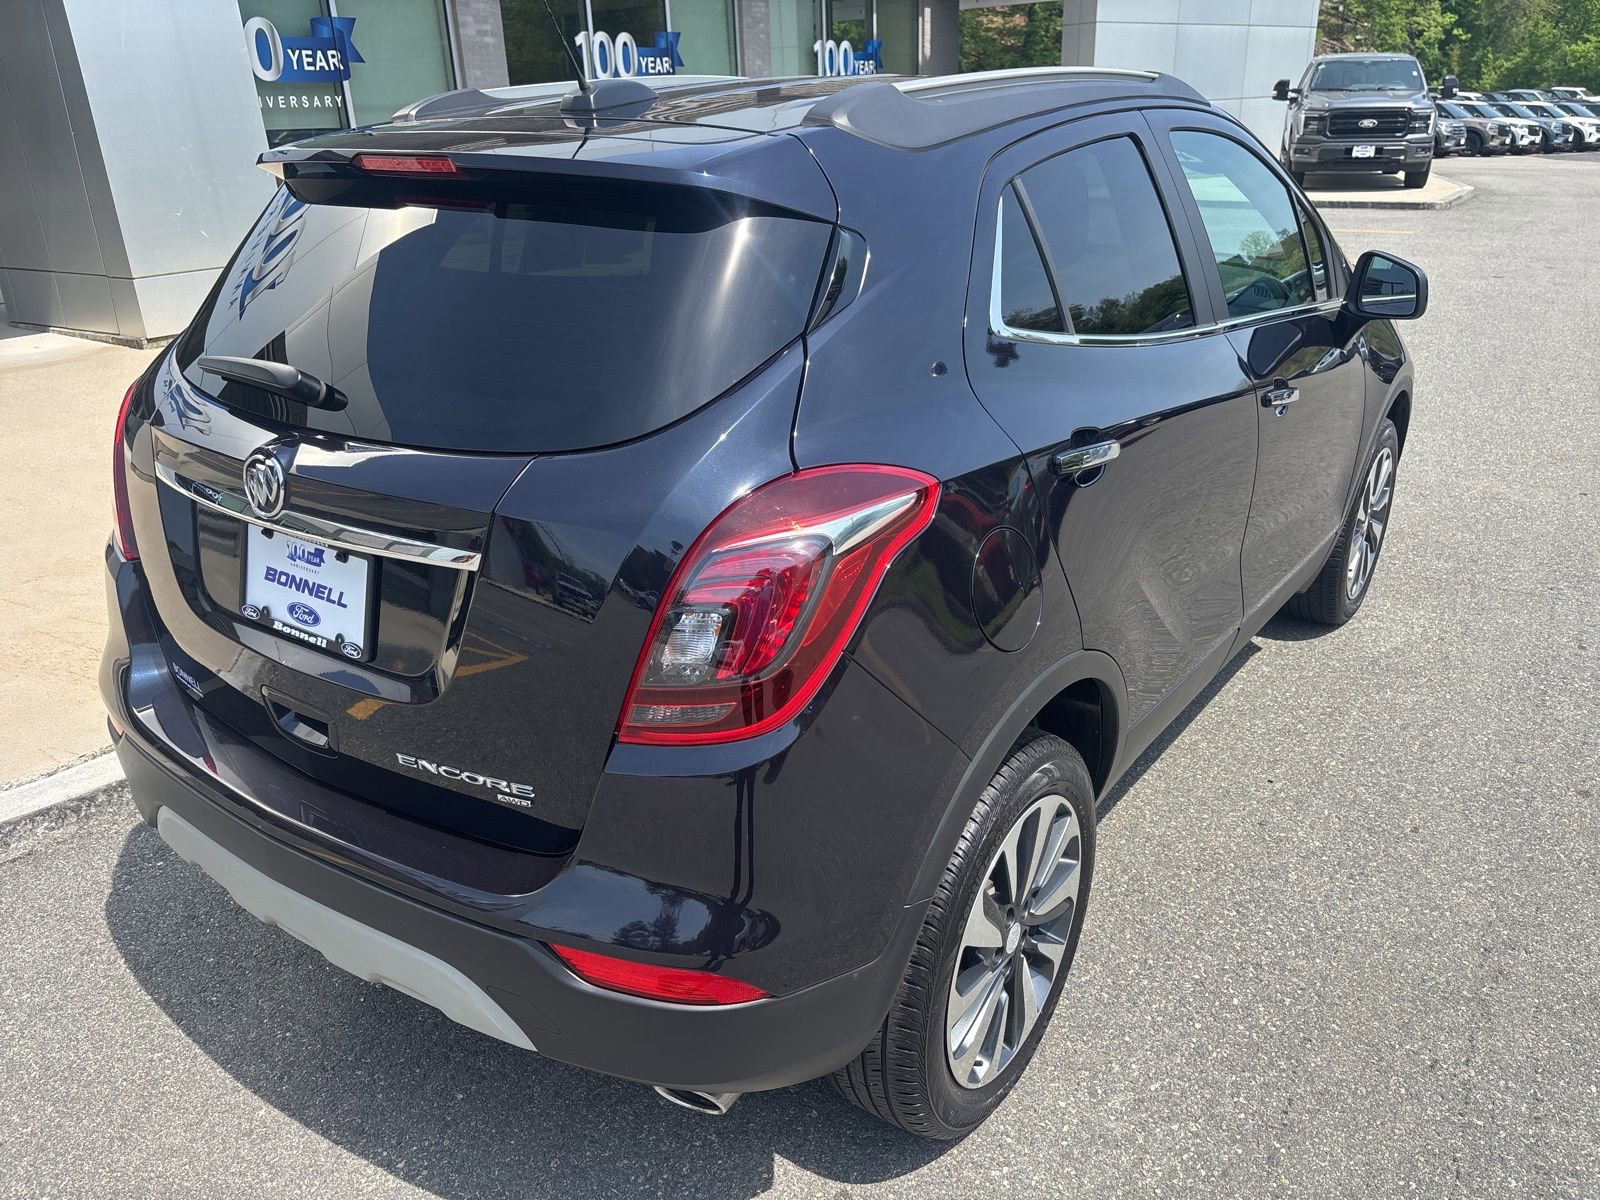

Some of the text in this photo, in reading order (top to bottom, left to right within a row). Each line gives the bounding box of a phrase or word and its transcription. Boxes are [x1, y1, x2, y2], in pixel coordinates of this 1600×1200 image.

[287, 49, 345, 71] YEAR
[574, 31, 674, 80] 100 YEAR
[813, 39, 877, 77] 100 YEAR
[287, 540, 307, 561] 100
[264, 565, 348, 609] BONNELL
[291, 604, 317, 625] Ford
[272, 620, 328, 648] Bonnell
[396, 752, 536, 798] ENCORE
[497, 794, 532, 807] AWD
